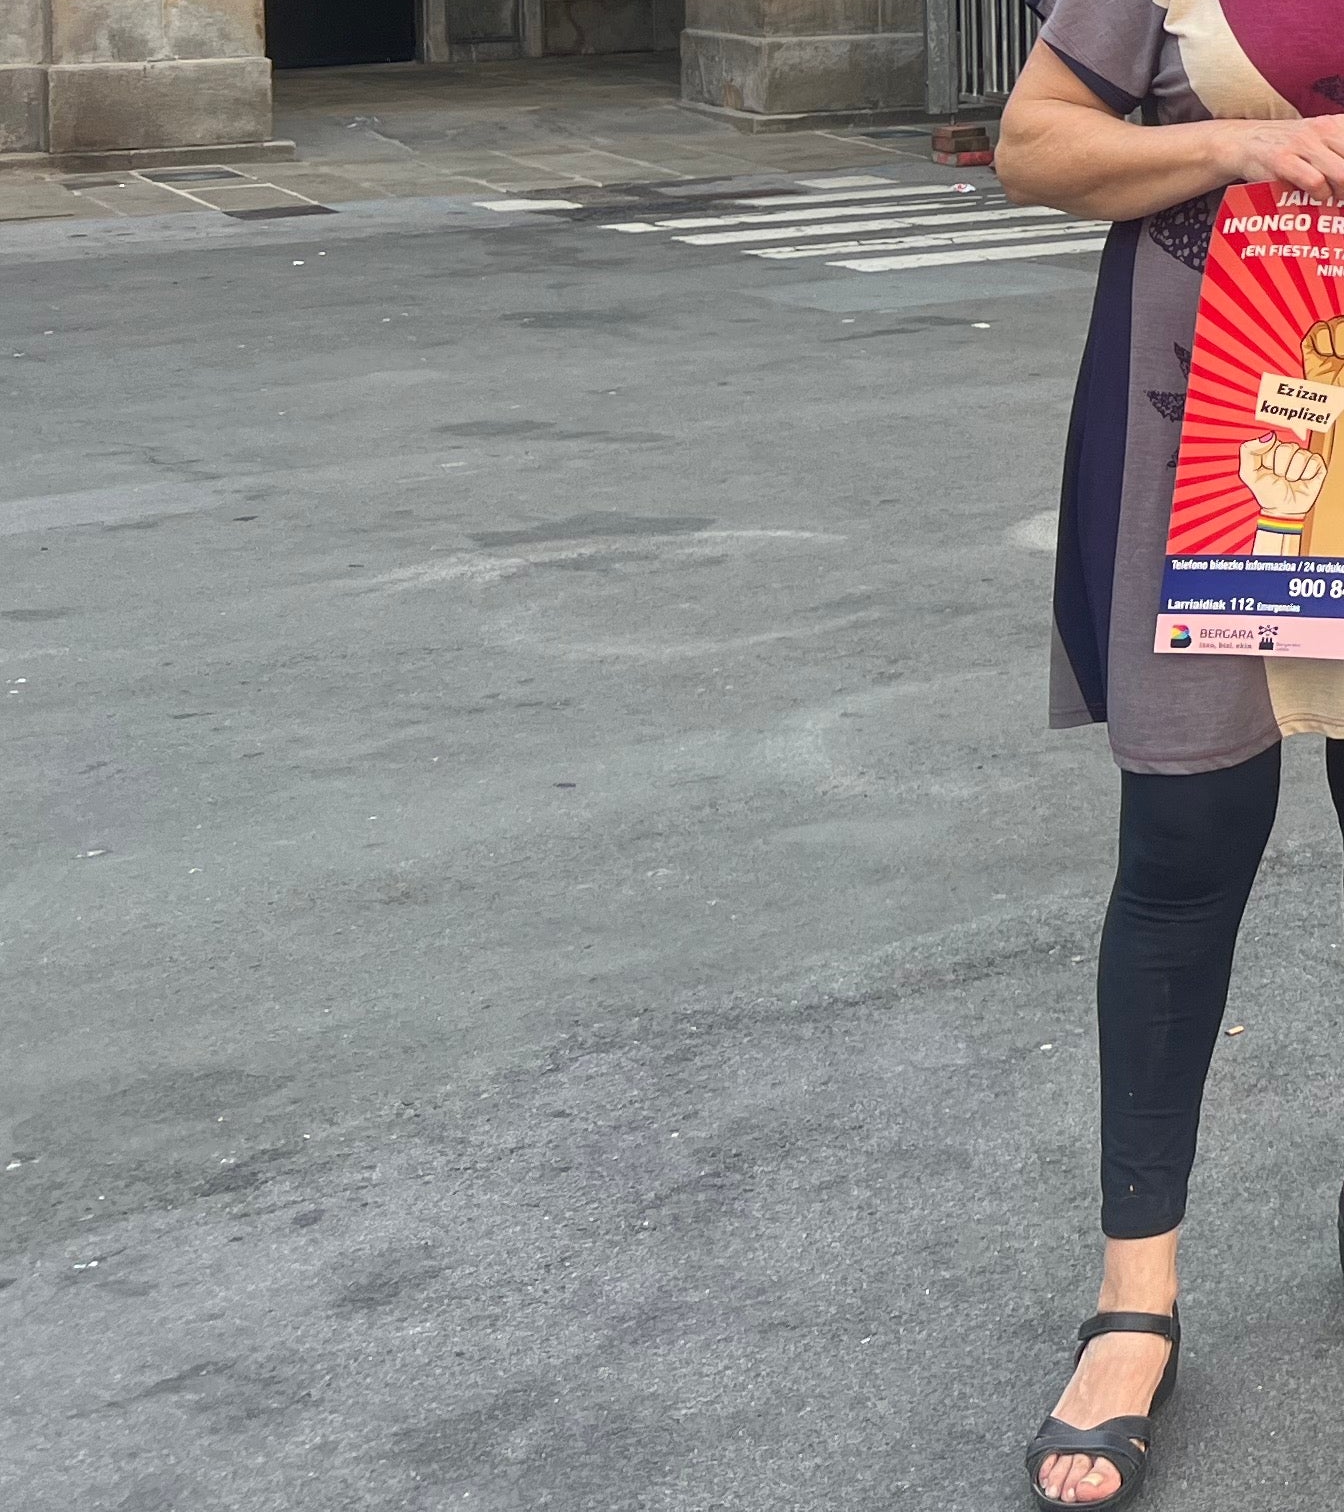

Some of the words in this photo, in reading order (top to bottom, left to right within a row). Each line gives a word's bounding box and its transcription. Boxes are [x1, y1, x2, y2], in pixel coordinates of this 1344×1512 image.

[1222, 213, 1312, 234] INONGO
[1241, 245, 1266, 259] ¡EN
[1269, 244, 1330, 259] FIESTAS
[1277, 383, 1293, 396] Ez
[1296, 386, 1328, 403] izan
[1260, 400, 1331, 425] konplize!
[1171, 559, 1208, 571] Telefono
[1209, 560, 1244, 571] bidezko
[1303, 561, 1315, 572] 24
[1289, 578, 1326, 598] 900
[1167, 598, 1226, 610] Larrialdiak
[1230, 597, 1254, 611] 112
[1200, 628, 1254, 639] BERGARA
